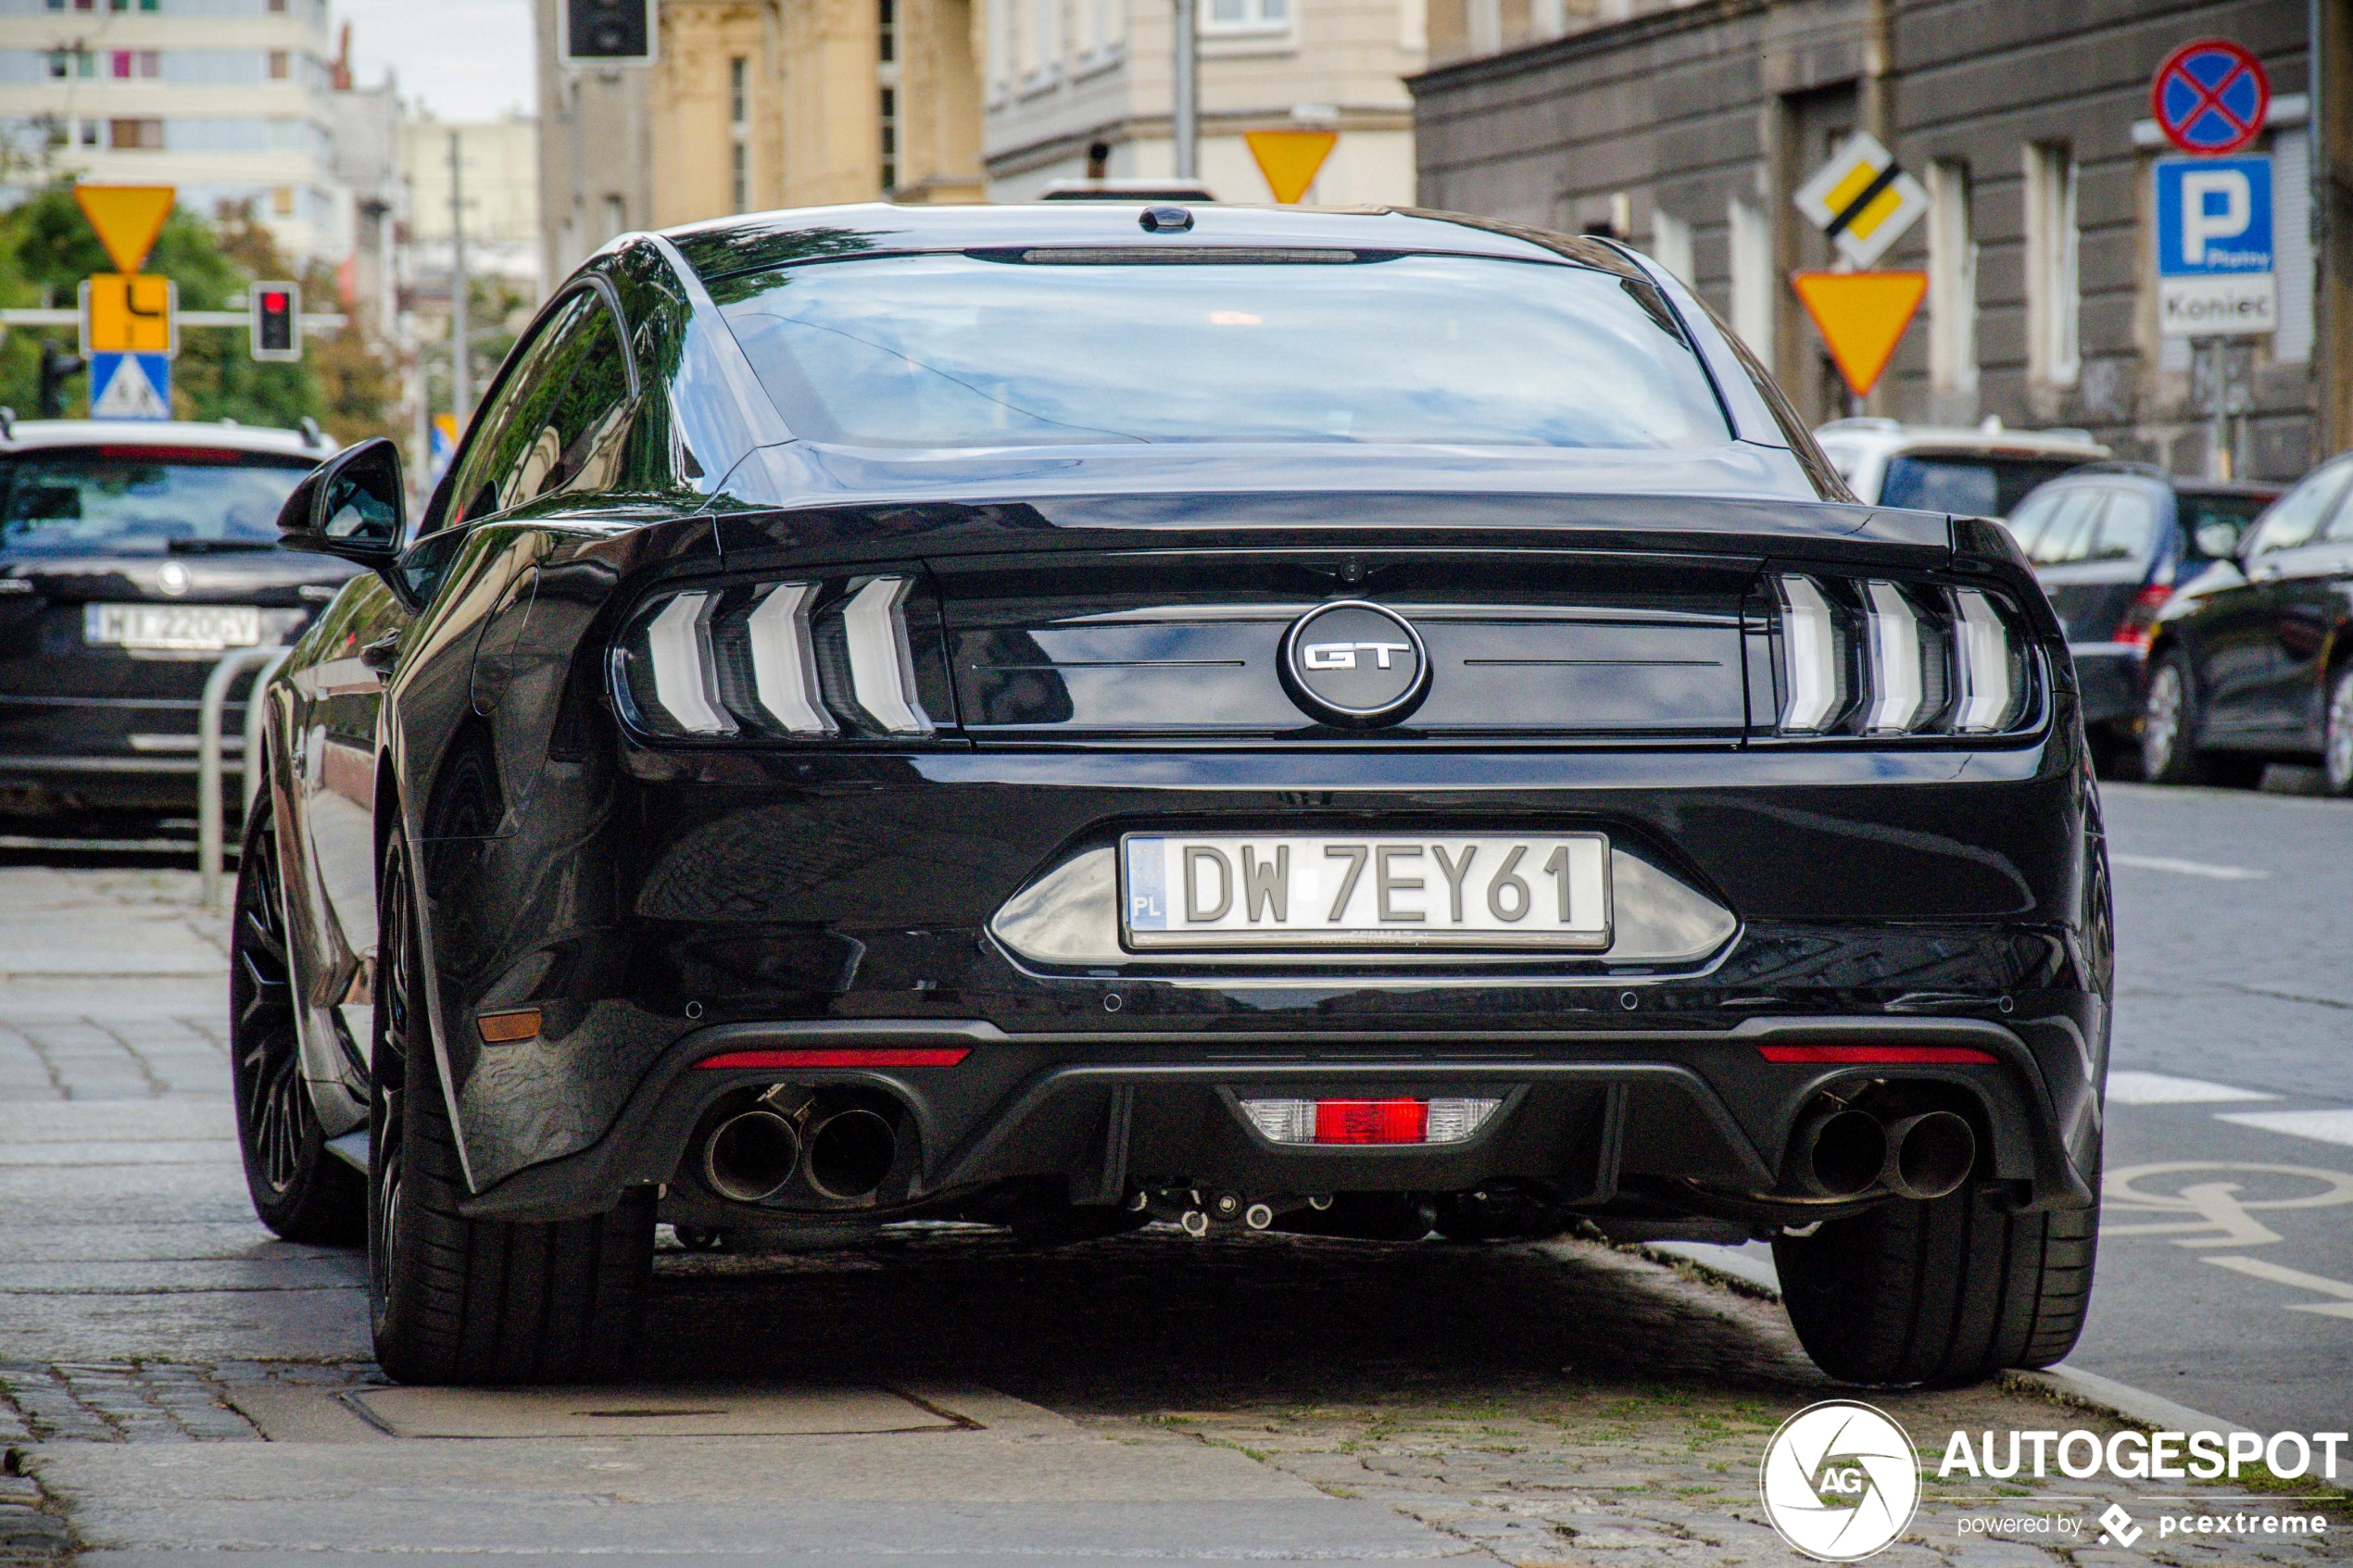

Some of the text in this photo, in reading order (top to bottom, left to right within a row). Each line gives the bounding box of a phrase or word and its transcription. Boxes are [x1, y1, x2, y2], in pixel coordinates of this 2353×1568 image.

[2182, 169, 2251, 265] P
[2167, 289, 2269, 320] Koniec
[1303, 642, 1410, 670] GT
[1183, 844, 1573, 924] DW 7EY61
[1133, 897, 1161, 917] PL
